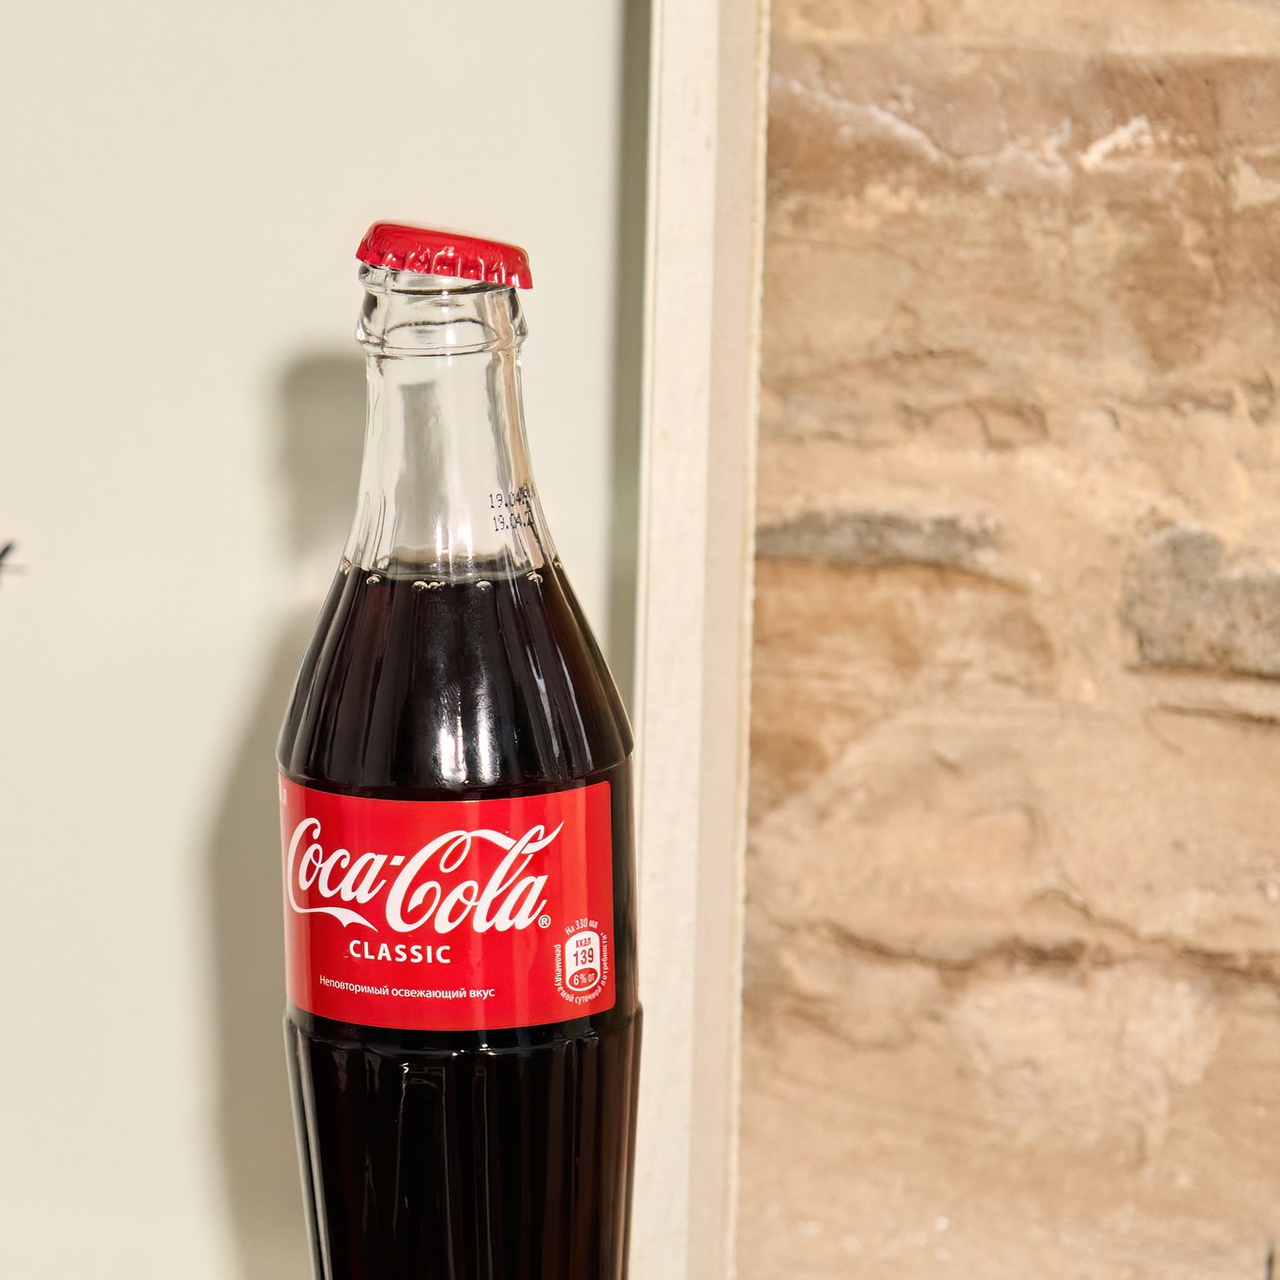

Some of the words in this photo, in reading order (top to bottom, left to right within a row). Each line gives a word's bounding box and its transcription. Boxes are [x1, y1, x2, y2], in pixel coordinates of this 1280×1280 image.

[287, 816, 564, 934] Coca-Cola
[575, 917, 588, 930] 330
[348, 939, 451, 964] CLASSIC
[575, 937, 592, 949] ккал
[573, 947, 594, 967] 139
[319, 974, 389, 998] Неповторимый
[391, 984, 466, 1001] освежающий
[468, 986, 495, 1001] вкус
